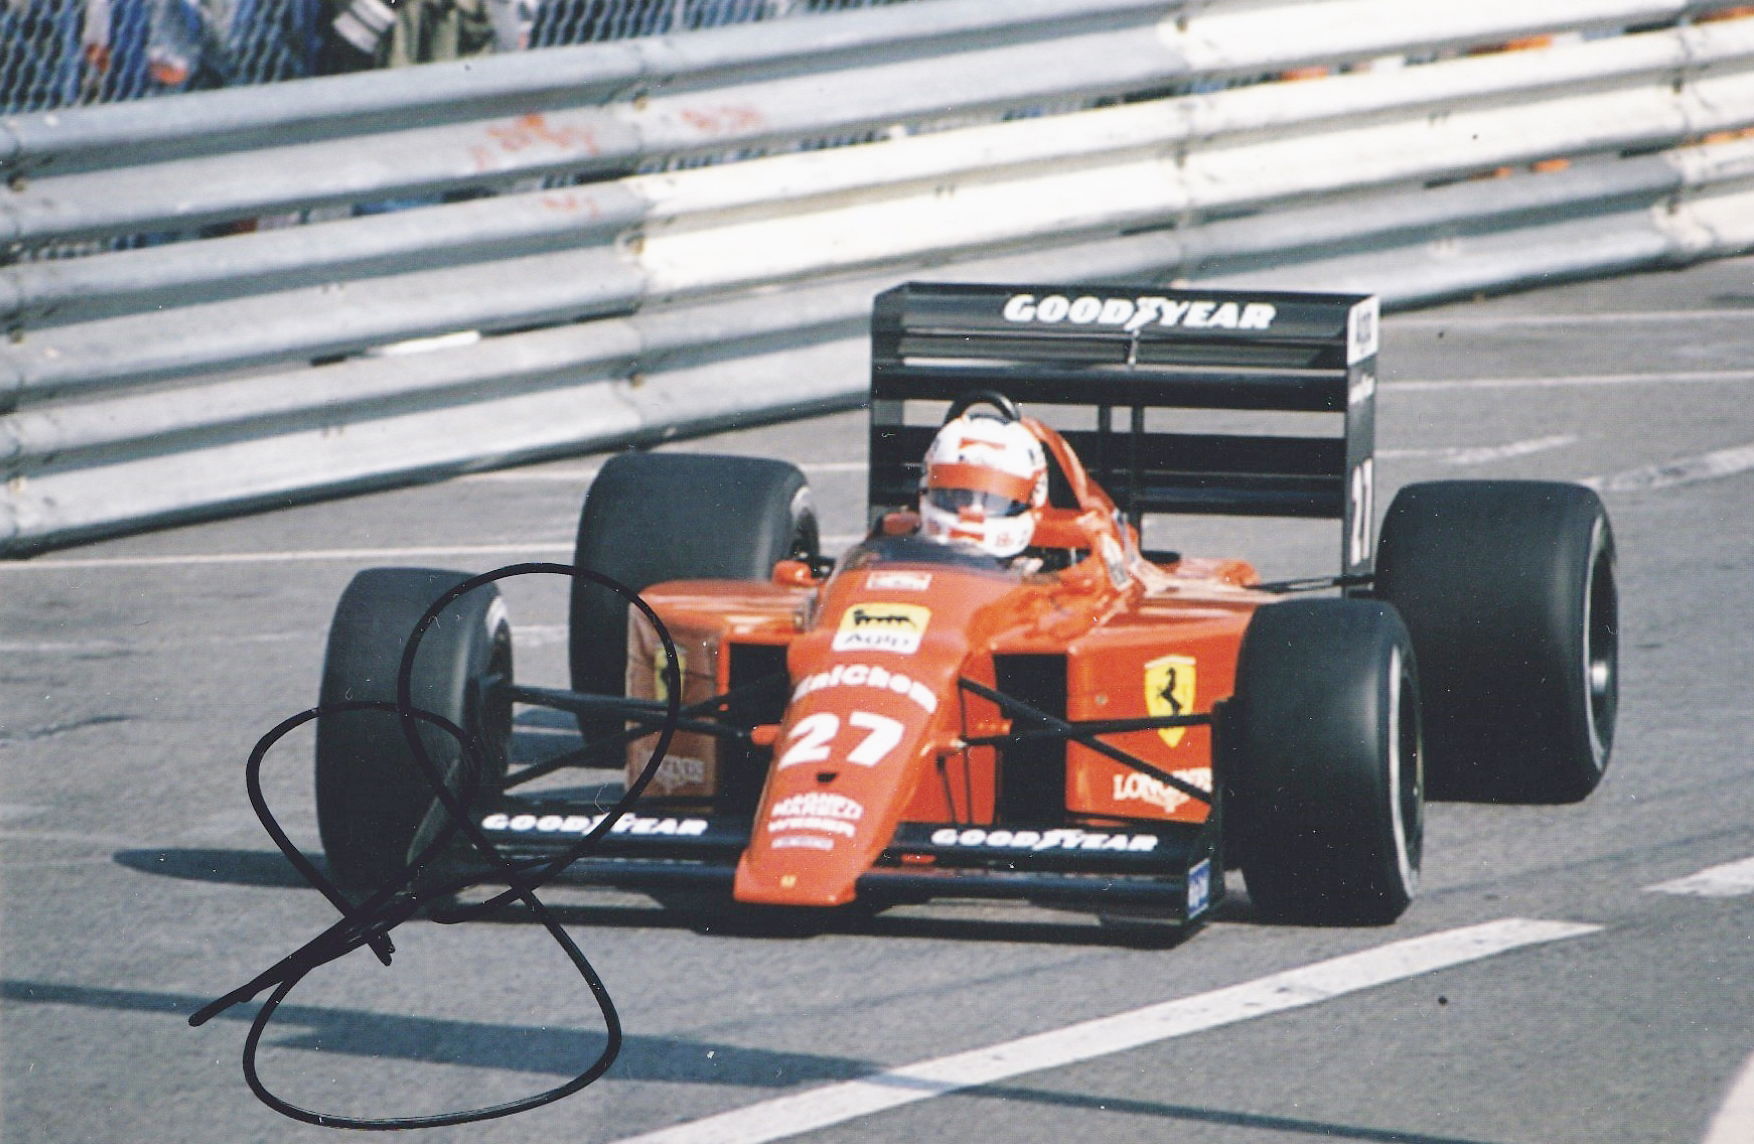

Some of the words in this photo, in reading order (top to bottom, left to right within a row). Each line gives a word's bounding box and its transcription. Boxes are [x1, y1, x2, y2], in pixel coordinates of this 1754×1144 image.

[1003, 293, 1276, 332] GOODYEAR
[777, 711, 905, 771] 27
[931, 828, 1158, 851] GOODYEAR
